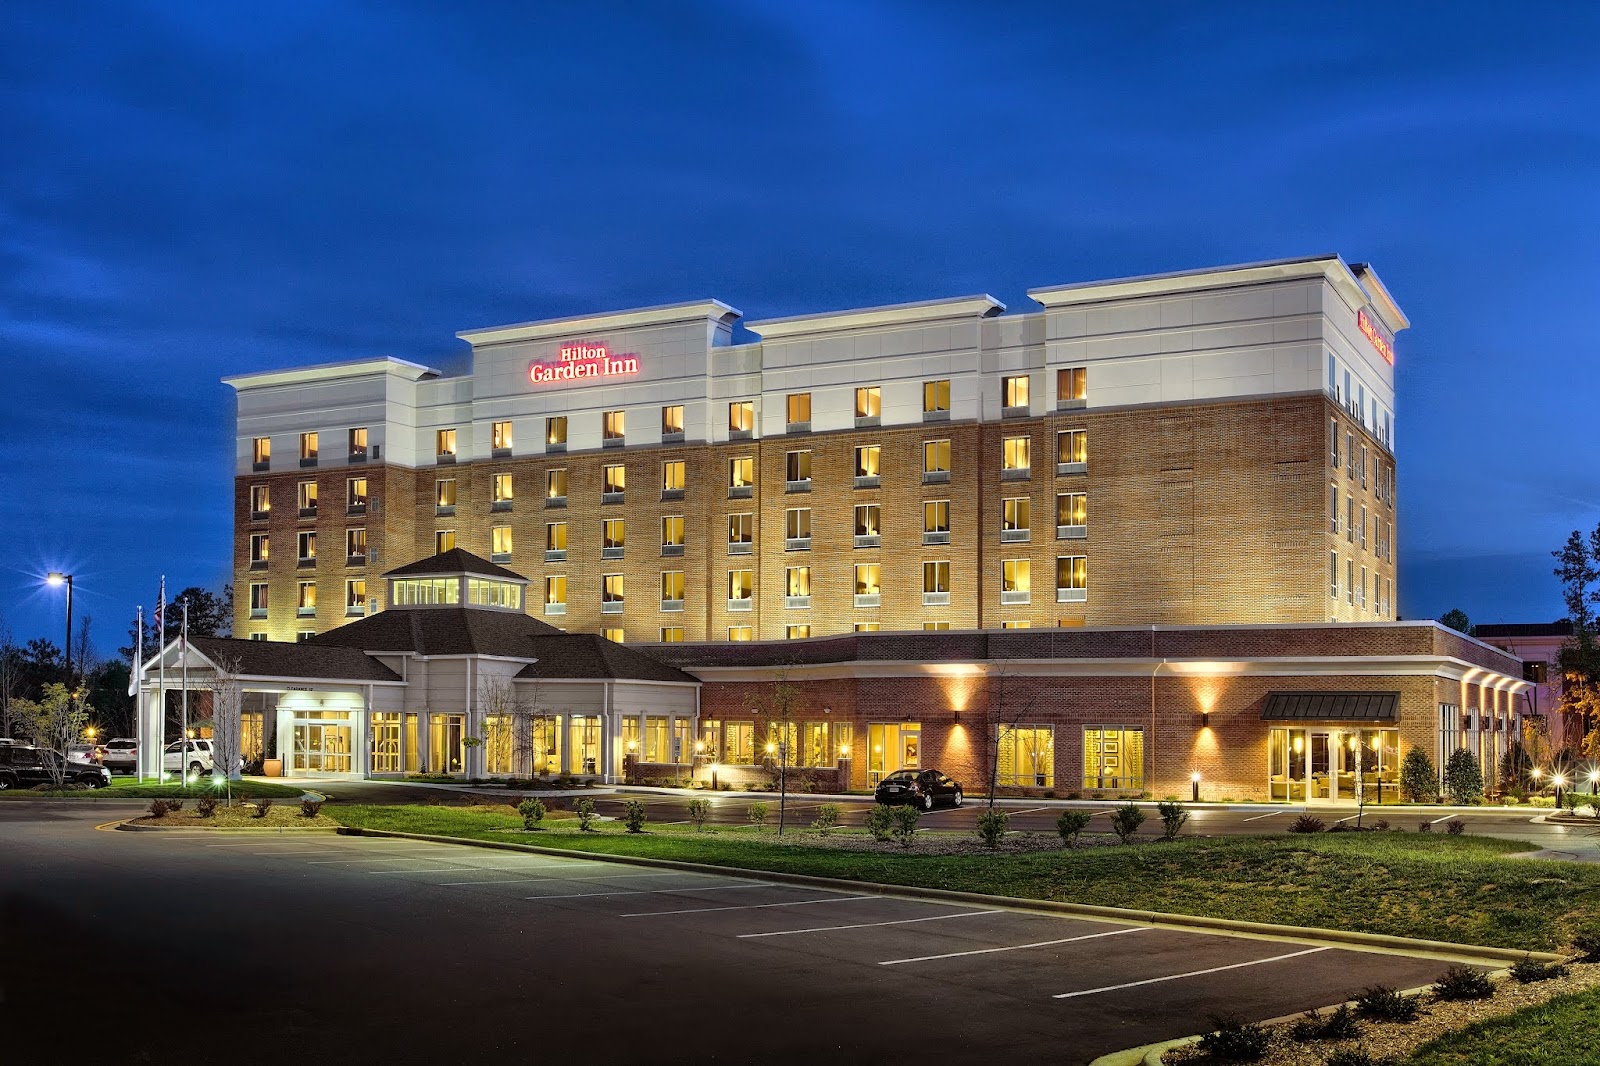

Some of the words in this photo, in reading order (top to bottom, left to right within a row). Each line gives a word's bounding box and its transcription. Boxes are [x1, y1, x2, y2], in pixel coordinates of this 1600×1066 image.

[561, 347, 606, 361] Hilton
[530, 361, 598, 383] Garden
[603, 357, 638, 376] Inn
